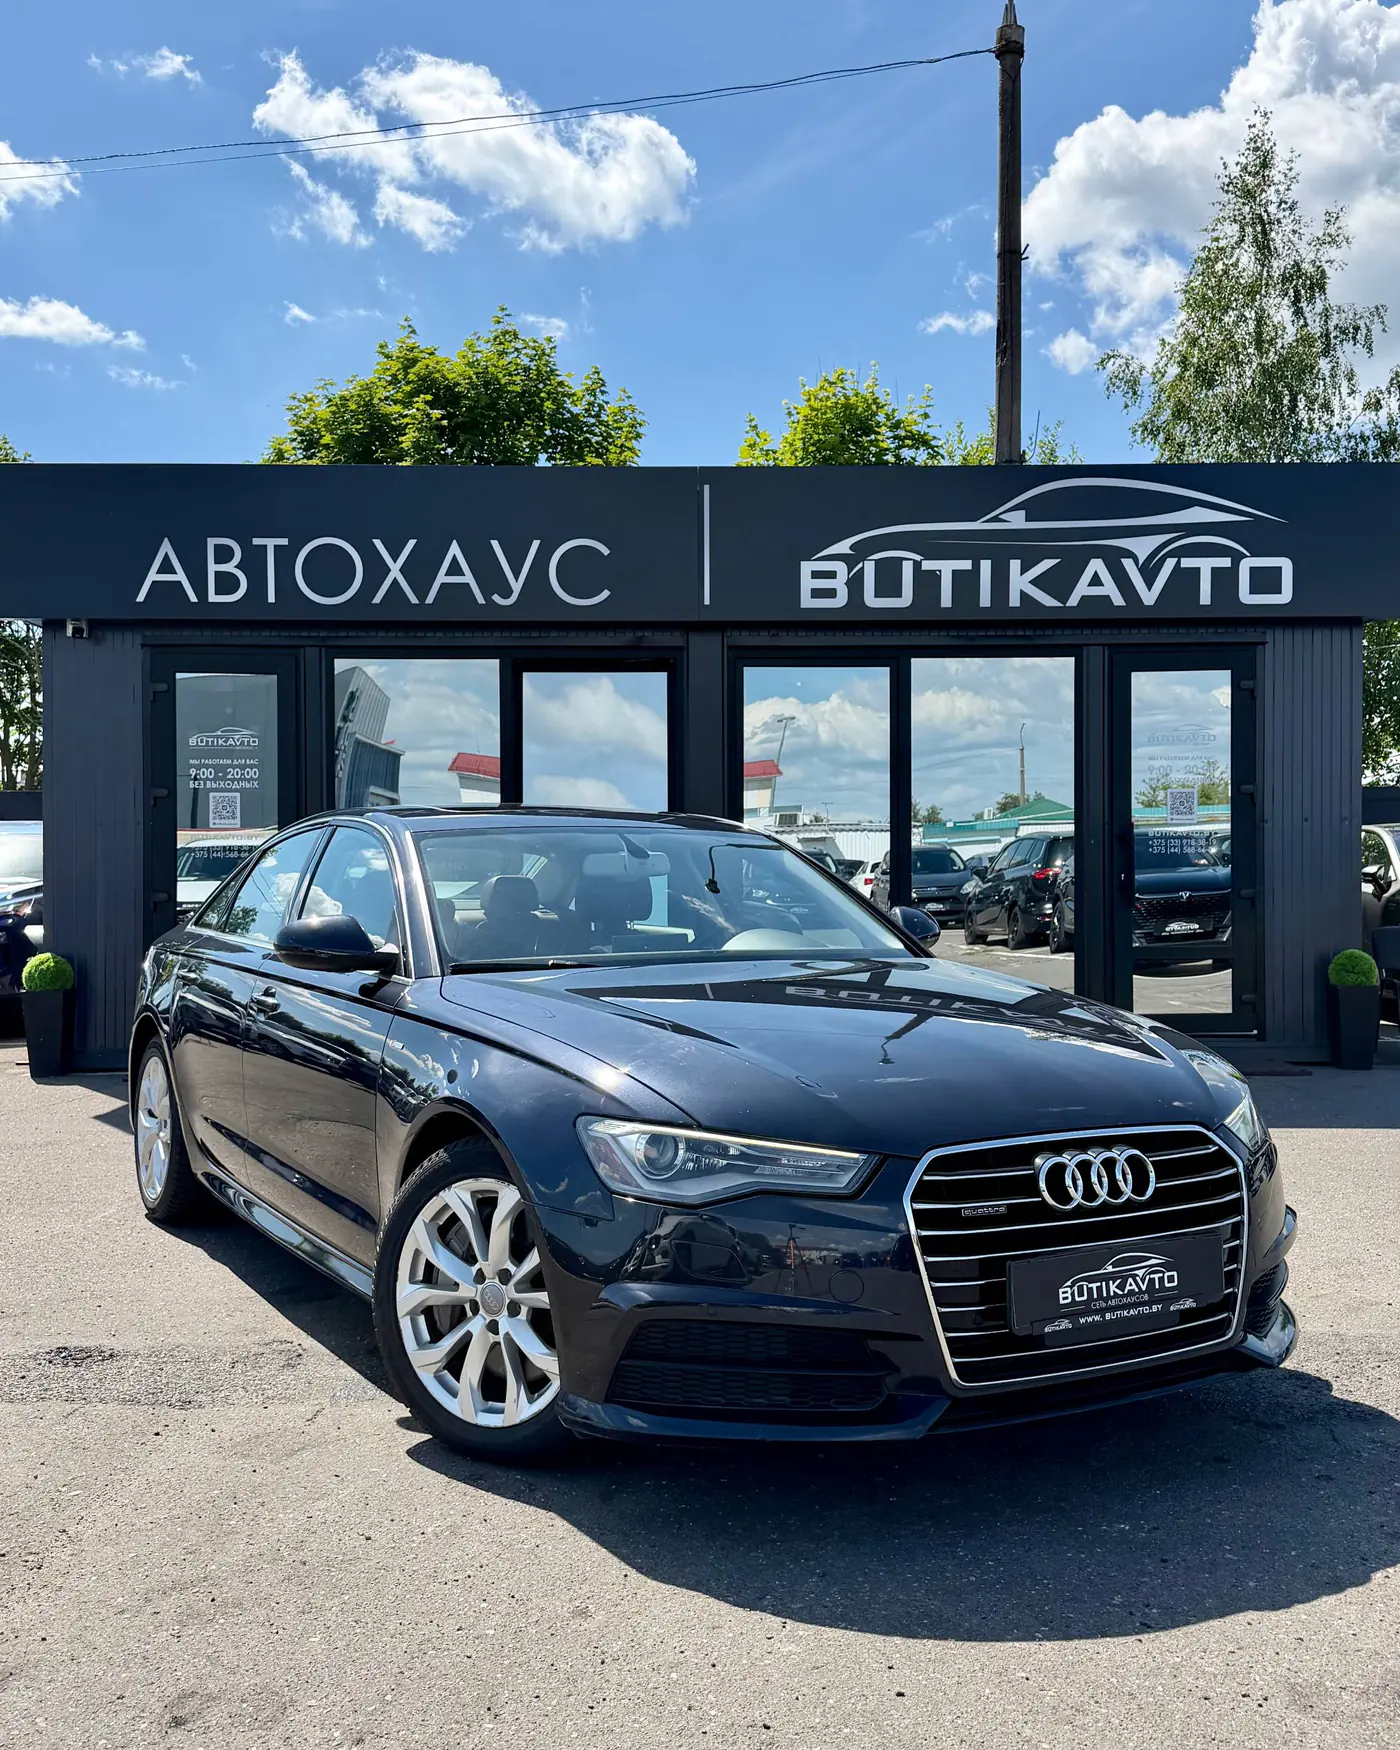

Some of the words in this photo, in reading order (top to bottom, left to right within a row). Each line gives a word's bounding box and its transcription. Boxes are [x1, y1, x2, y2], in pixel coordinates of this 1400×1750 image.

[136, 536, 612, 606] АВТОХАУС
[799, 555, 1294, 609] BUTIKAVTO
[189, 737, 259, 746] BUTIKAVTO
[190, 768, 215, 779] 9:00
[226, 768, 259, 779] 20:00
[189, 780, 204, 789] БЕЗ
[206, 780, 259, 790] ВЫХОДНЫХ
[963, 1207, 1006, 1216] quattro
[1058, 1271, 1179, 1305] BUTIKAVTO
[1107, 1293, 1150, 1306] АВТОХАУСОВ
[1105, 1304, 1163, 1321] BUTIKAVTO.BY
